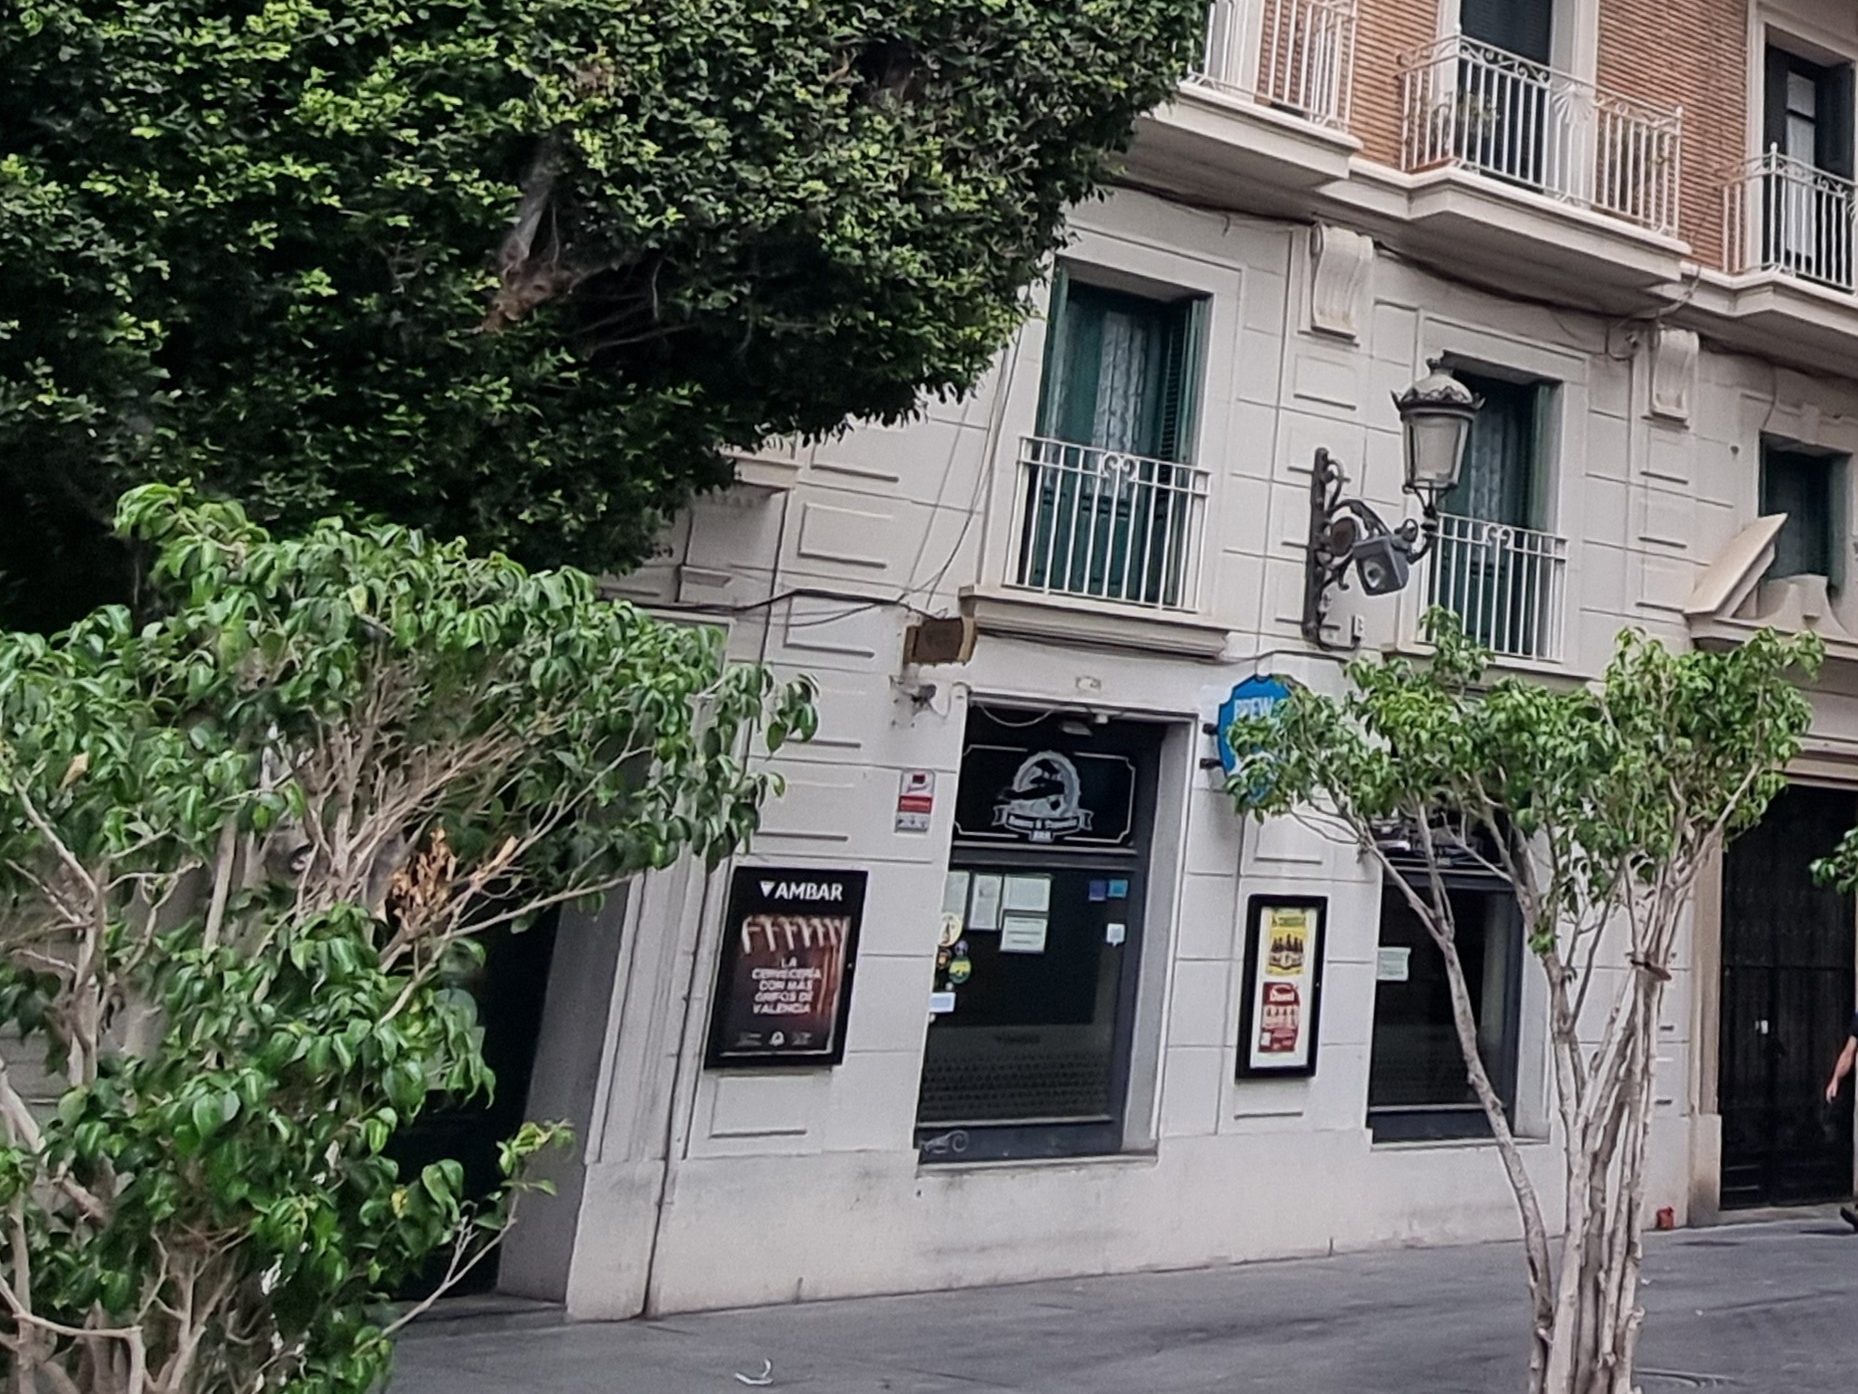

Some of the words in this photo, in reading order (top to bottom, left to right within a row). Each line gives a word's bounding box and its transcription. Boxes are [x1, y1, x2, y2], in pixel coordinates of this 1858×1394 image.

[774, 881, 843, 902] AMBAR
[780, 956, 798, 968] LA
[759, 980, 785, 991] CON
